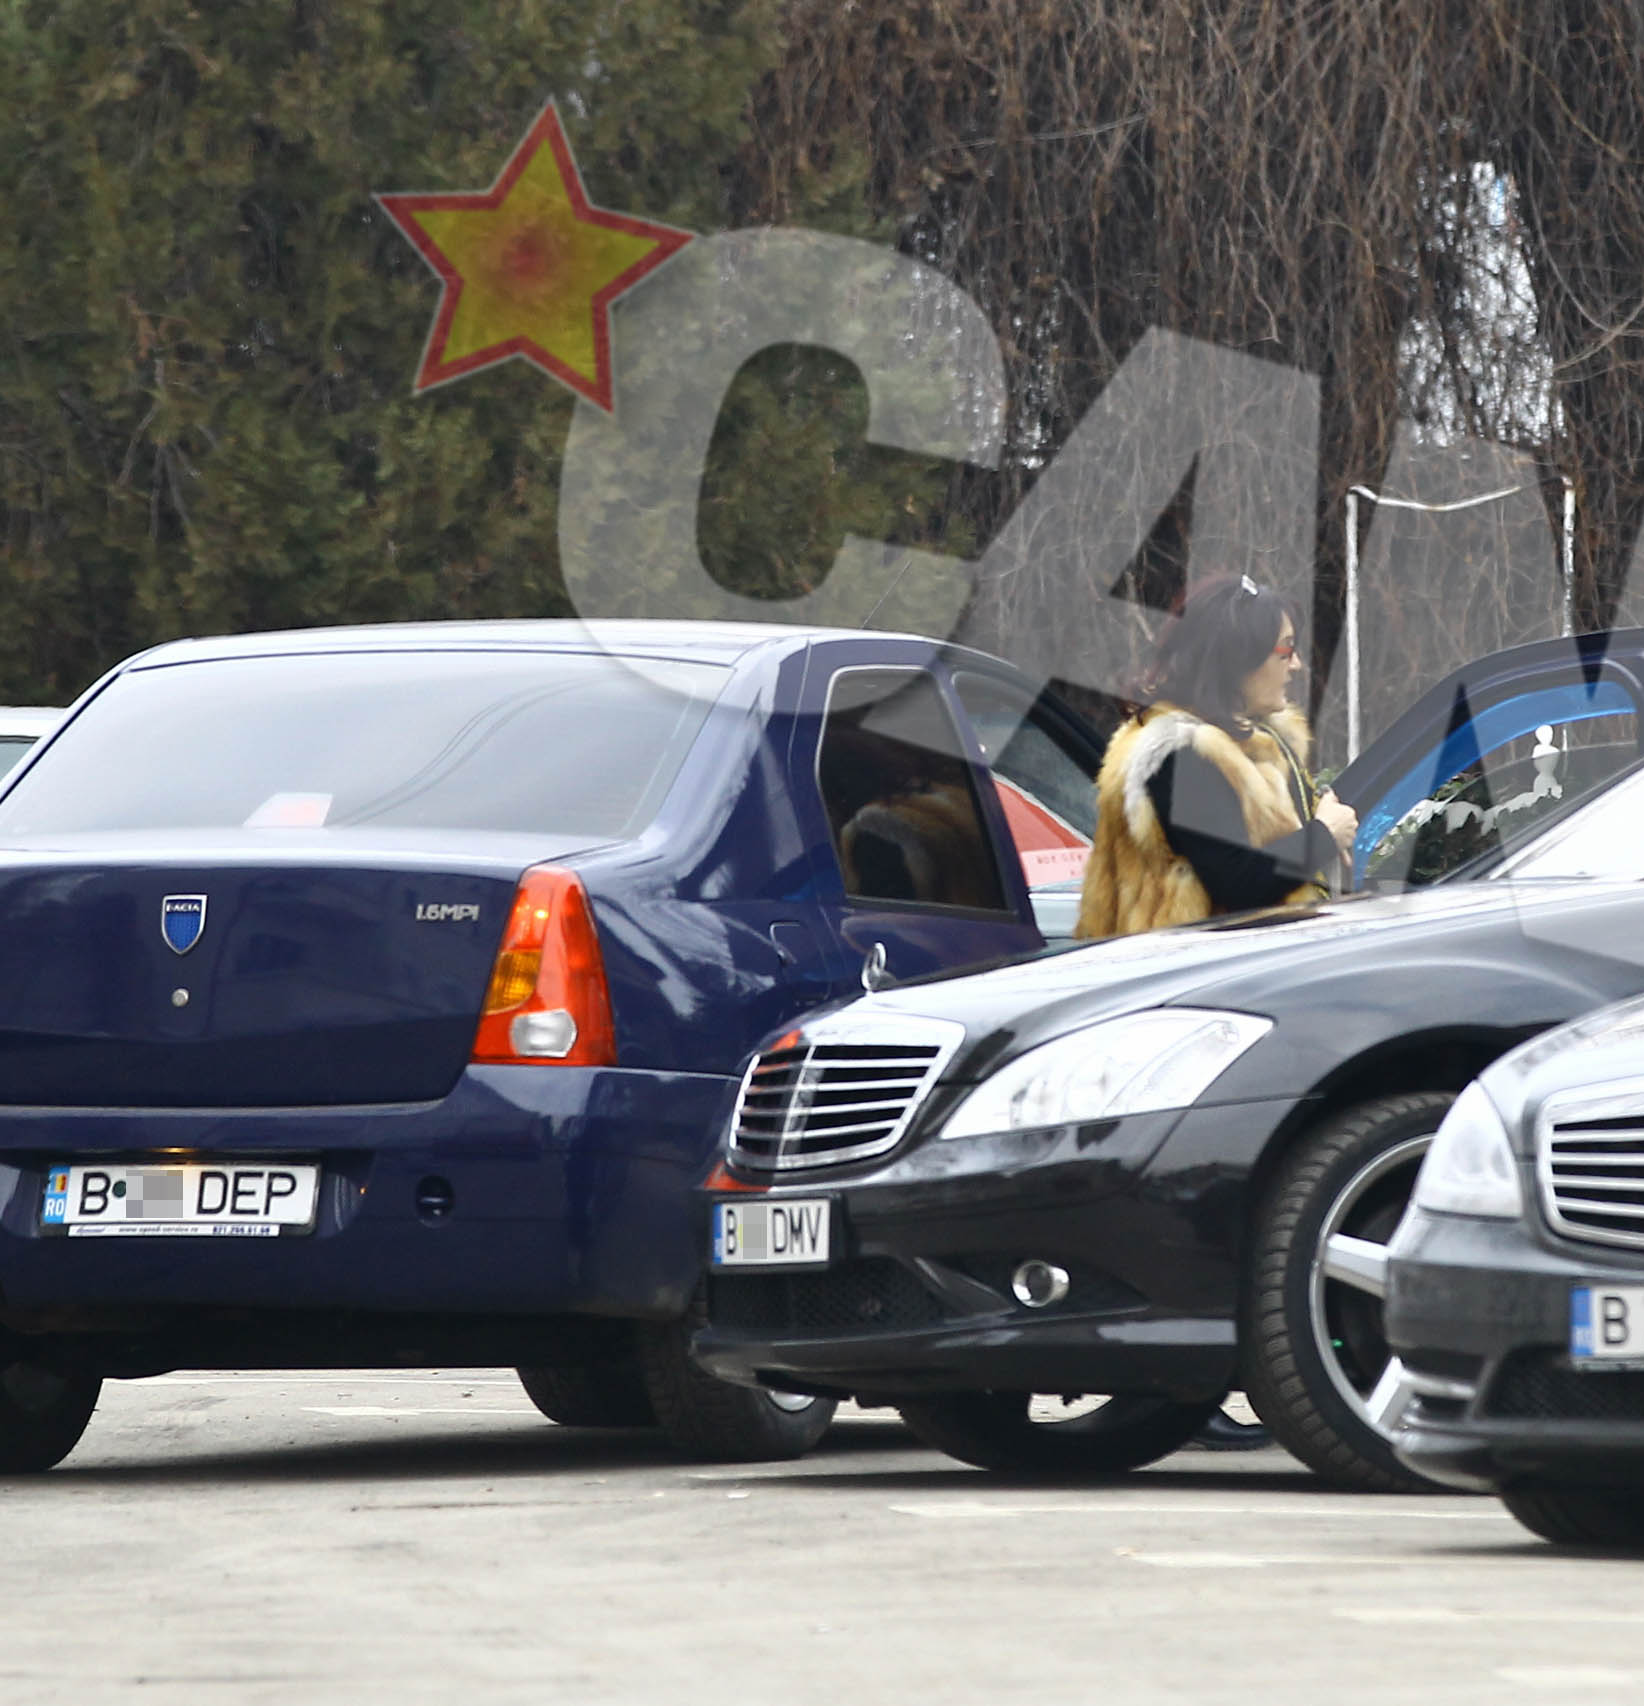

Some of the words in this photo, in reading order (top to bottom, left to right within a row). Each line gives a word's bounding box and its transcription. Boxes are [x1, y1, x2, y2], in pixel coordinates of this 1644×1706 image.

[45, 1199, 64, 1216] RO
[79, 1171, 111, 1216] B
[196, 1171, 298, 1216] DEP
[726, 1208, 738, 1255] B
[773, 1207, 821, 1254] DMV
[1602, 1296, 1630, 1345] B
